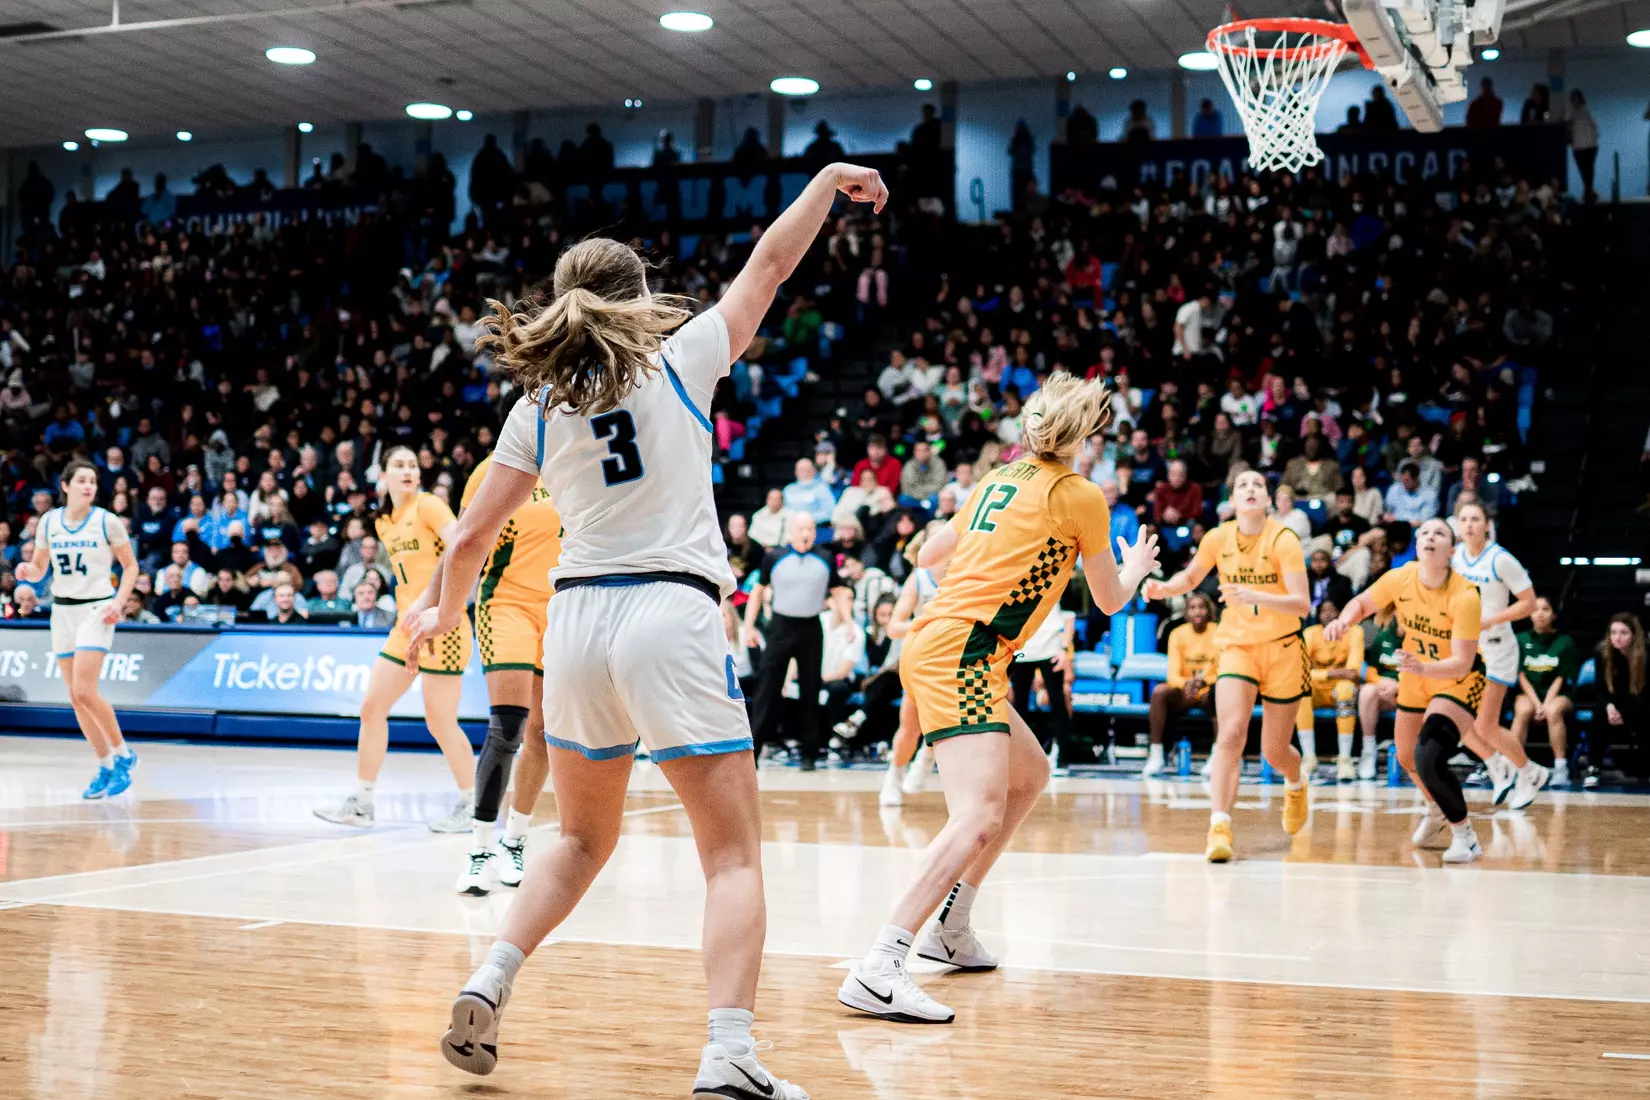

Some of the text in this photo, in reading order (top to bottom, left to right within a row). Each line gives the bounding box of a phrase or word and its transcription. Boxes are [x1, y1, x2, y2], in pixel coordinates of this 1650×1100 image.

[589, 409, 645, 488] 3
[969, 482, 1019, 532] 12
[56, 552, 87, 576] 24
[214, 652, 371, 692] TicketSm
